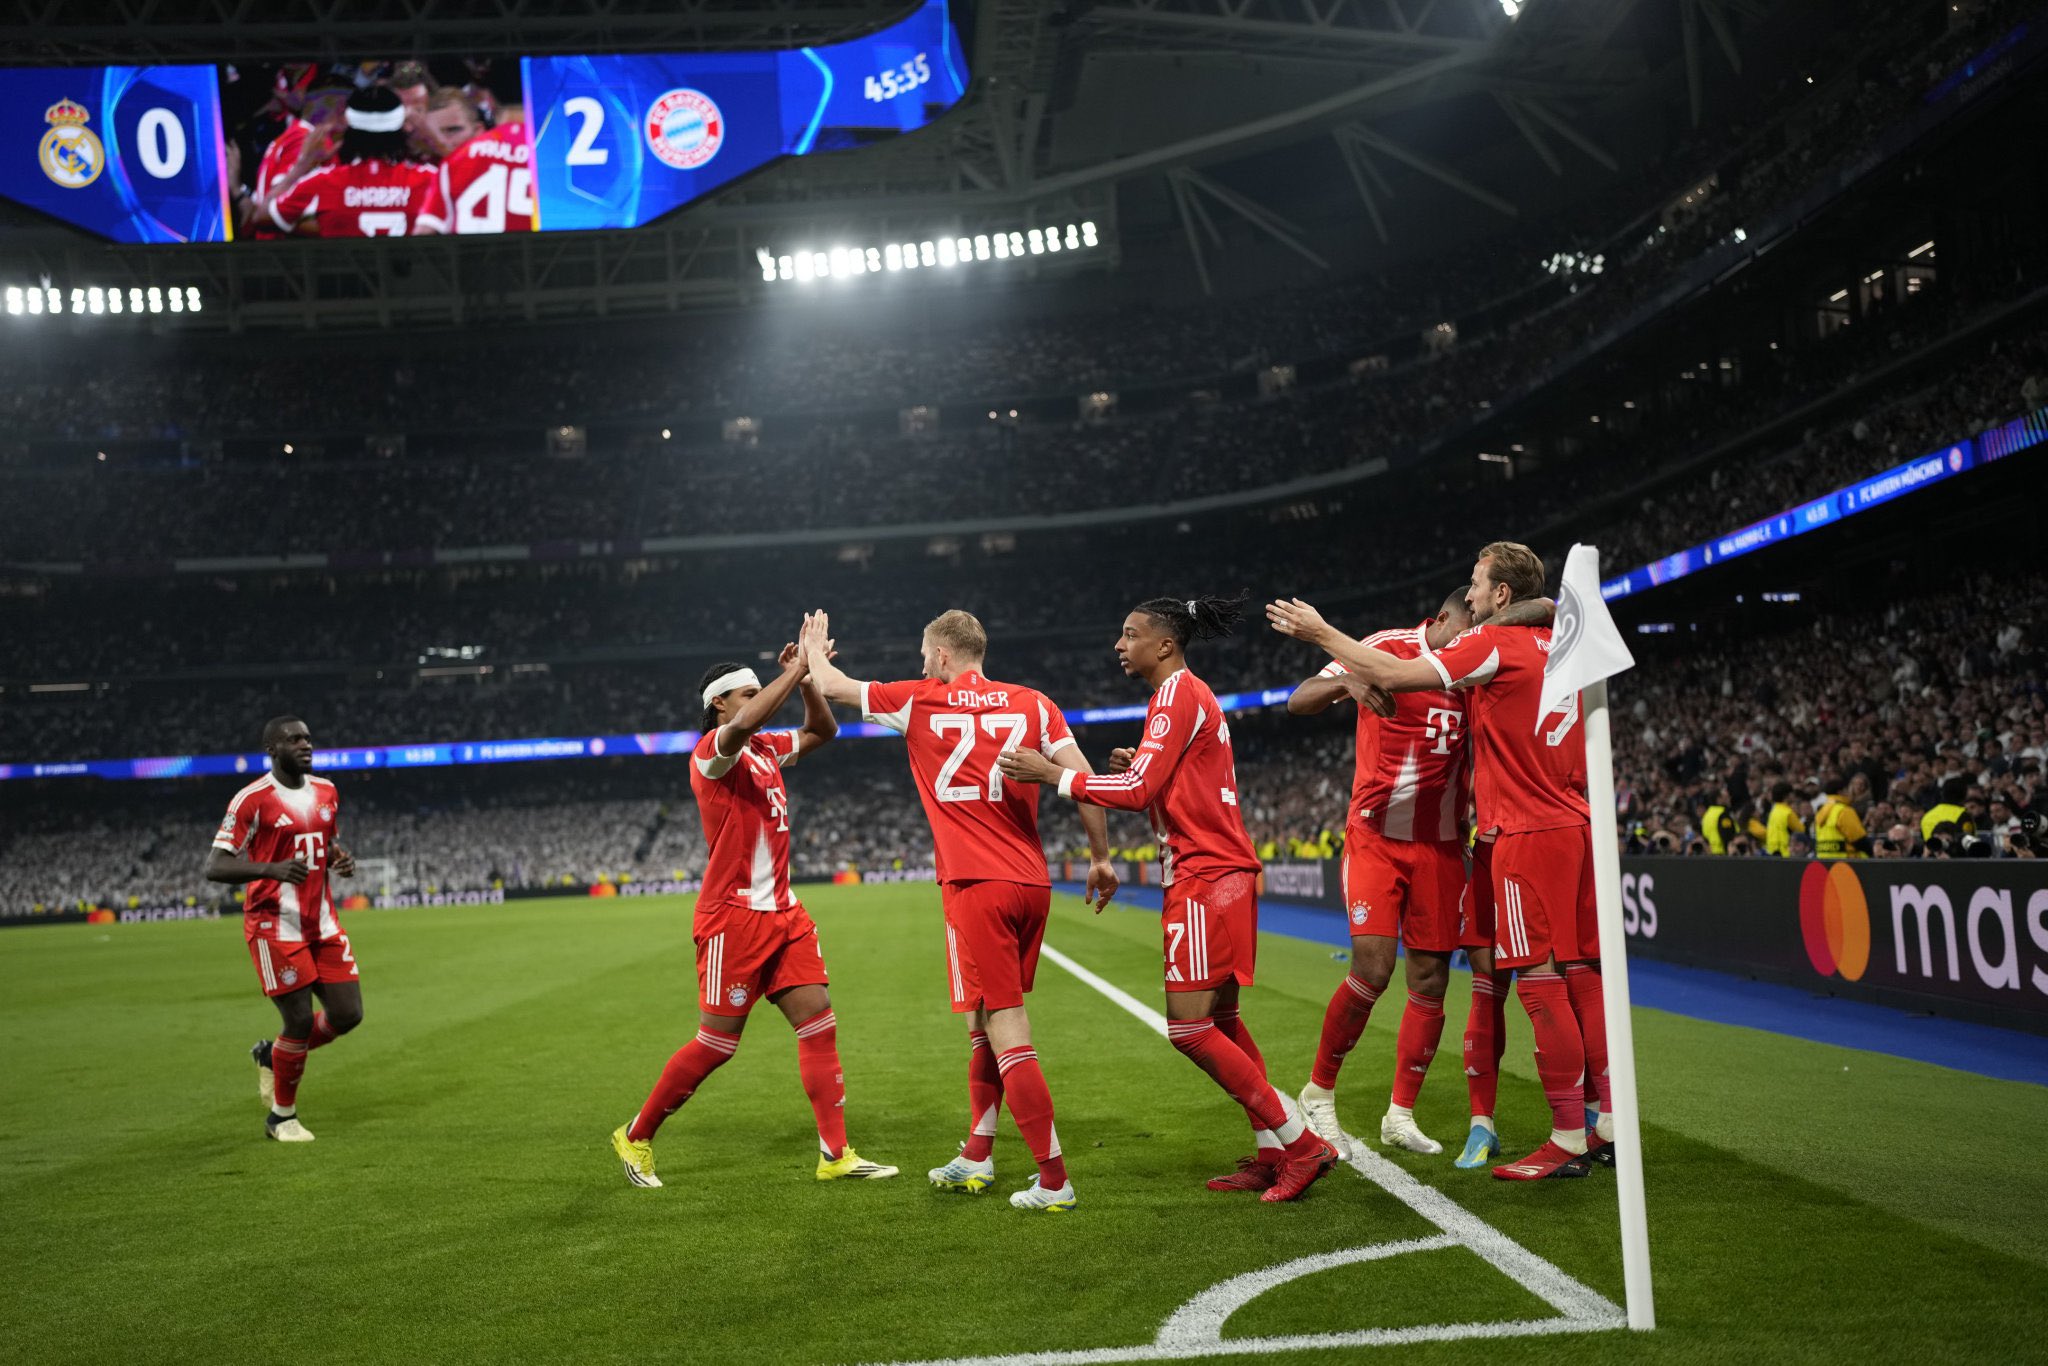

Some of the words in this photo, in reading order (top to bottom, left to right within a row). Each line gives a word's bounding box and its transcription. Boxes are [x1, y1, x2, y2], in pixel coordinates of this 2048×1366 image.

[864, 52, 931, 103] 45:35
[137, 107, 186, 179] 0
[563, 96, 608, 166] 2
[948, 690, 1009, 707] LAIMER
[1142, 740, 1164, 751] Allianz
[1426, 707, 1462, 755] T
[930, 713, 1028, 802] 27
[294, 832, 325, 870] T
[1167, 922, 1185, 963] 7
